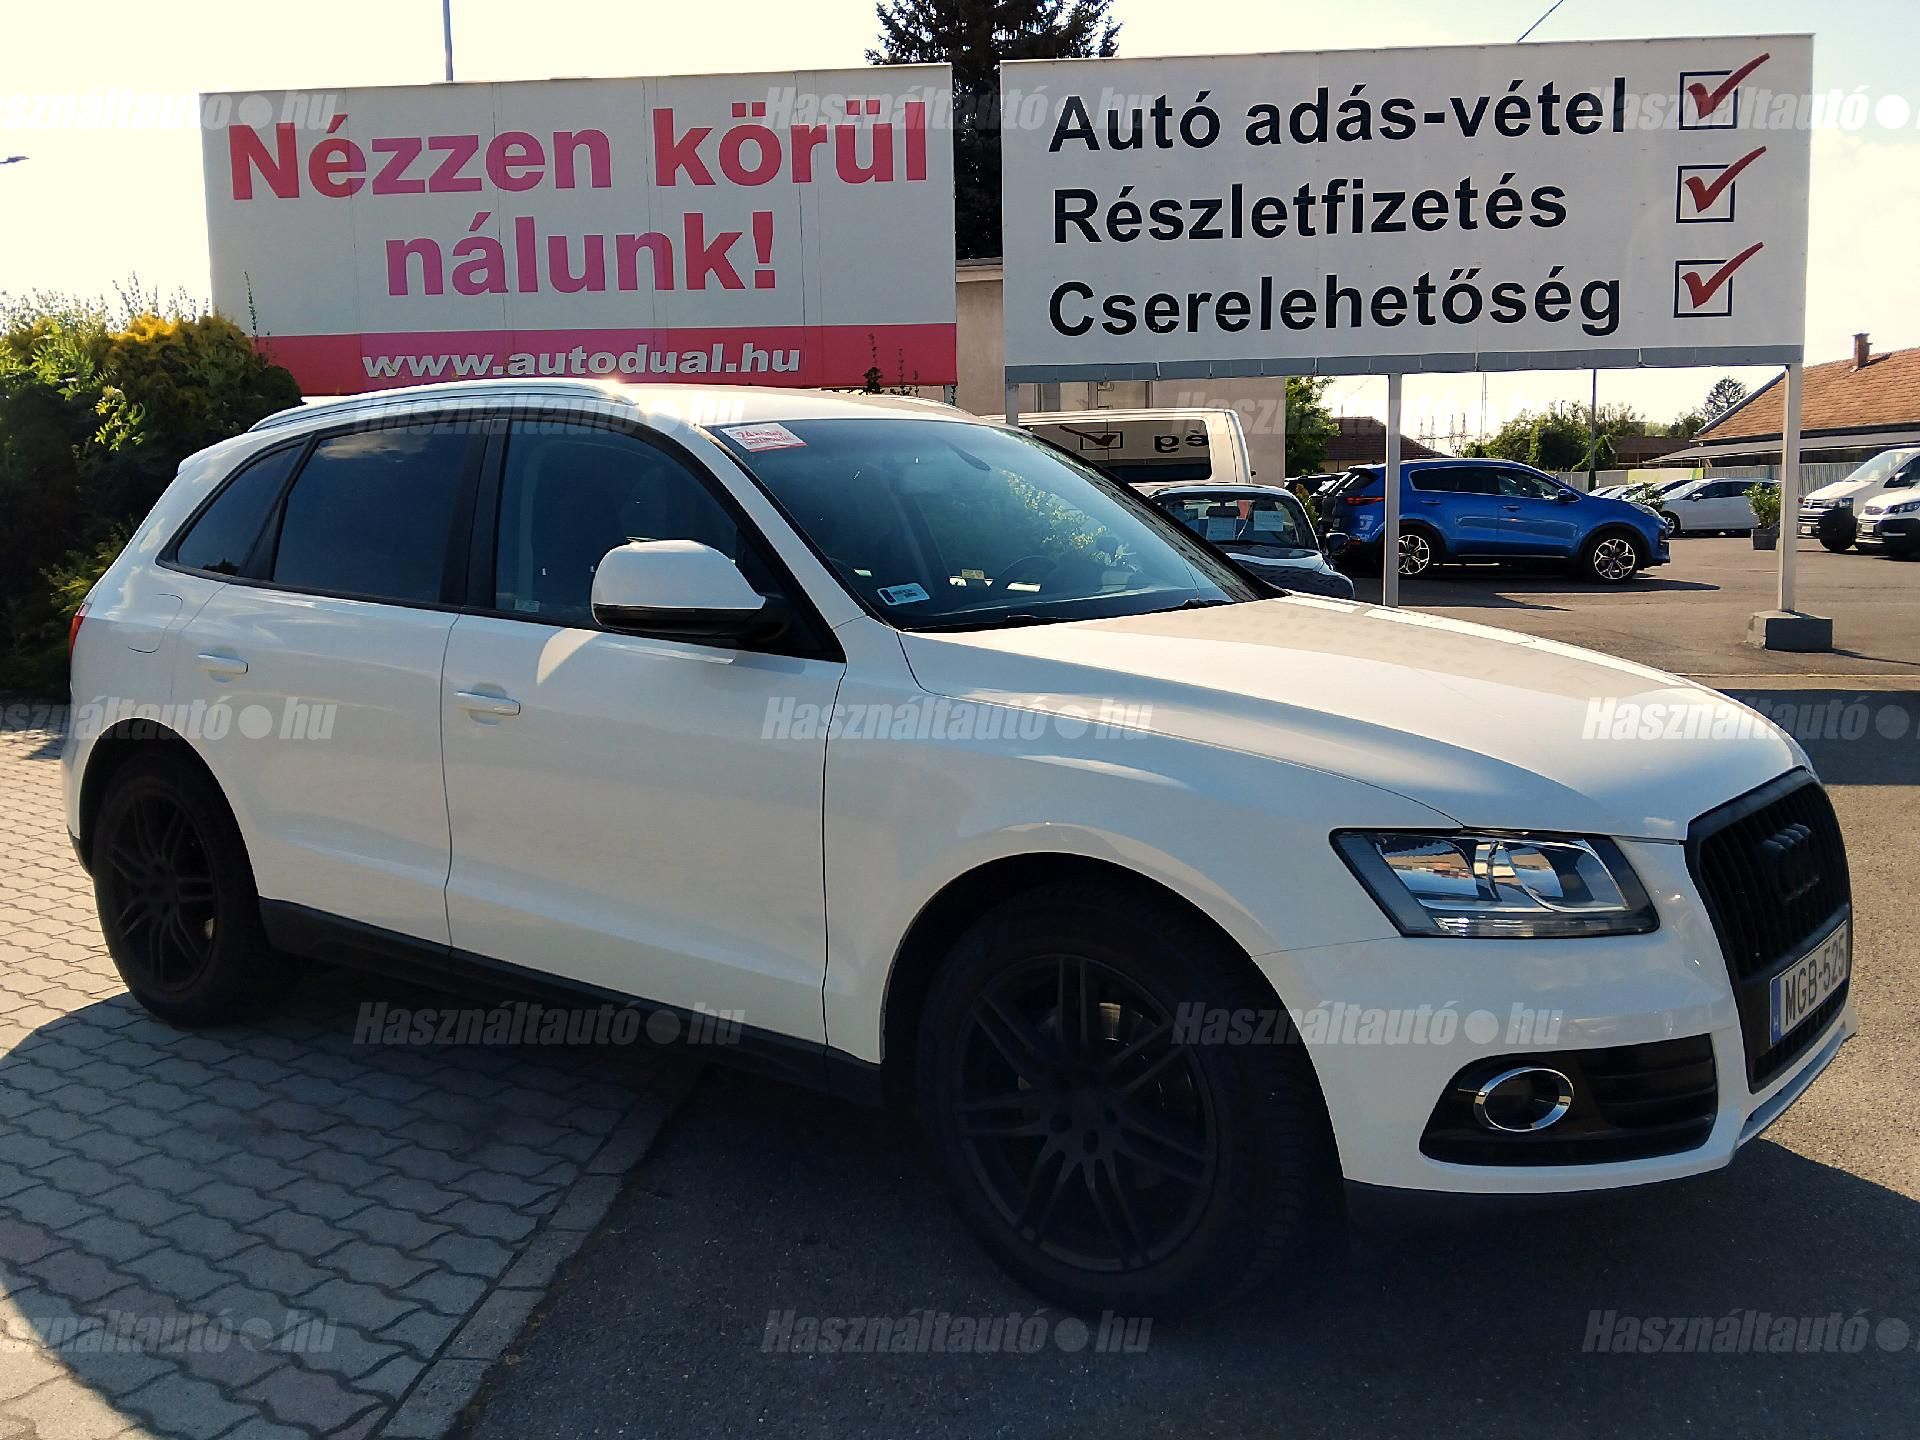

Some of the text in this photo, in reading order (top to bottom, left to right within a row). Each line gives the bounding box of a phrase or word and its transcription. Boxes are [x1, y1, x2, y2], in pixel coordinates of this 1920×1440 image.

[228, 101, 928, 201] Nézzen körül
[1048, 77, 1626, 153] Autó adás-vétel
[1053, 172, 1567, 244] Részletfizetés
[385, 211, 778, 297] nálunk!
[1048, 266, 1622, 338] Cserelehetőség
[361, 343, 801, 379] www.autodual.hu
[1785, 932, 1846, 1026] MGB-525
